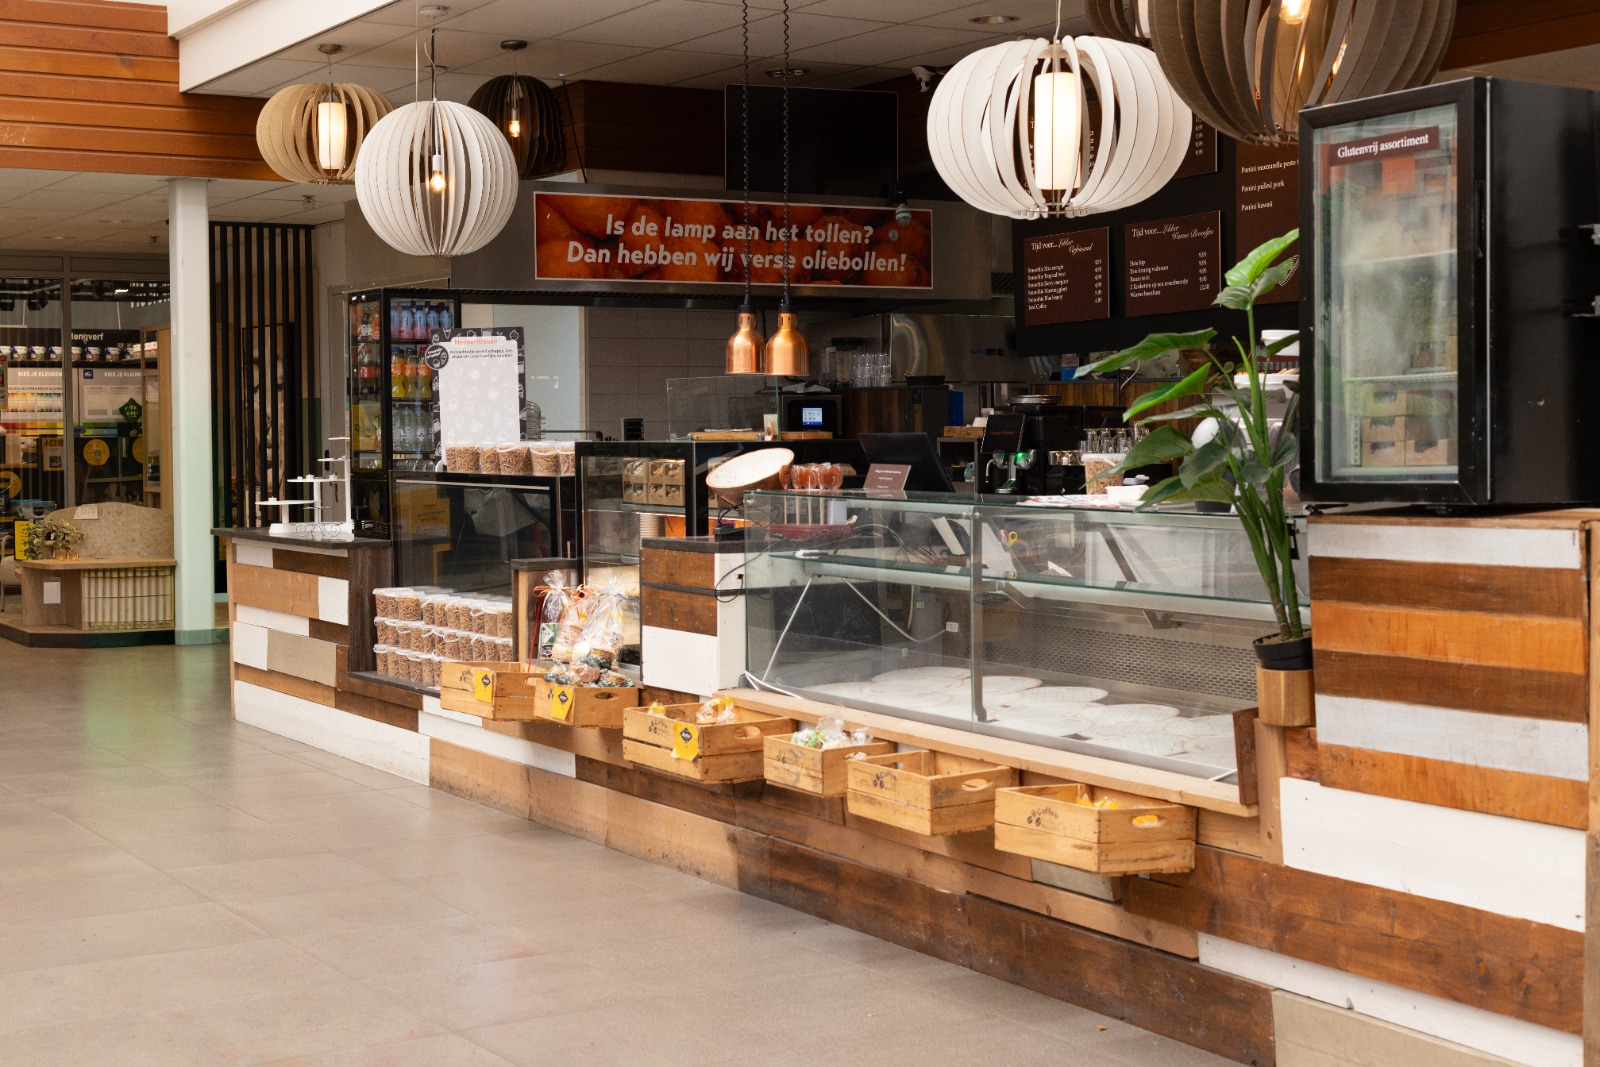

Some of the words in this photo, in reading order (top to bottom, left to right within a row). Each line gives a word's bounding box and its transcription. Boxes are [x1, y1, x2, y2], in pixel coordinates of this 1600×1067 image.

[1337, 142, 1378, 158] Glutenvrij
[1380, 134, 1429, 151] assortiment
[1258, 182, 1272, 192] pulled
[1273, 180, 1284, 188] pork
[606, 214, 624, 236] Is
[632, 216, 658, 238] de
[664, 216, 716, 243] lamp
[722, 224, 759, 240] aan
[766, 220, 798, 242] het
[806, 222, 874, 244] tollen?
[1132, 228, 1144, 238] Tijd
[1031, 242, 1042, 252] Tijd
[567, 241, 610, 264] Dan
[617, 243, 698, 266] hebben
[704, 248, 734, 272] wij
[741, 252, 796, 268] verse
[802, 250, 907, 272] oliebollen!
[71, 332, 104, 342] engverf
